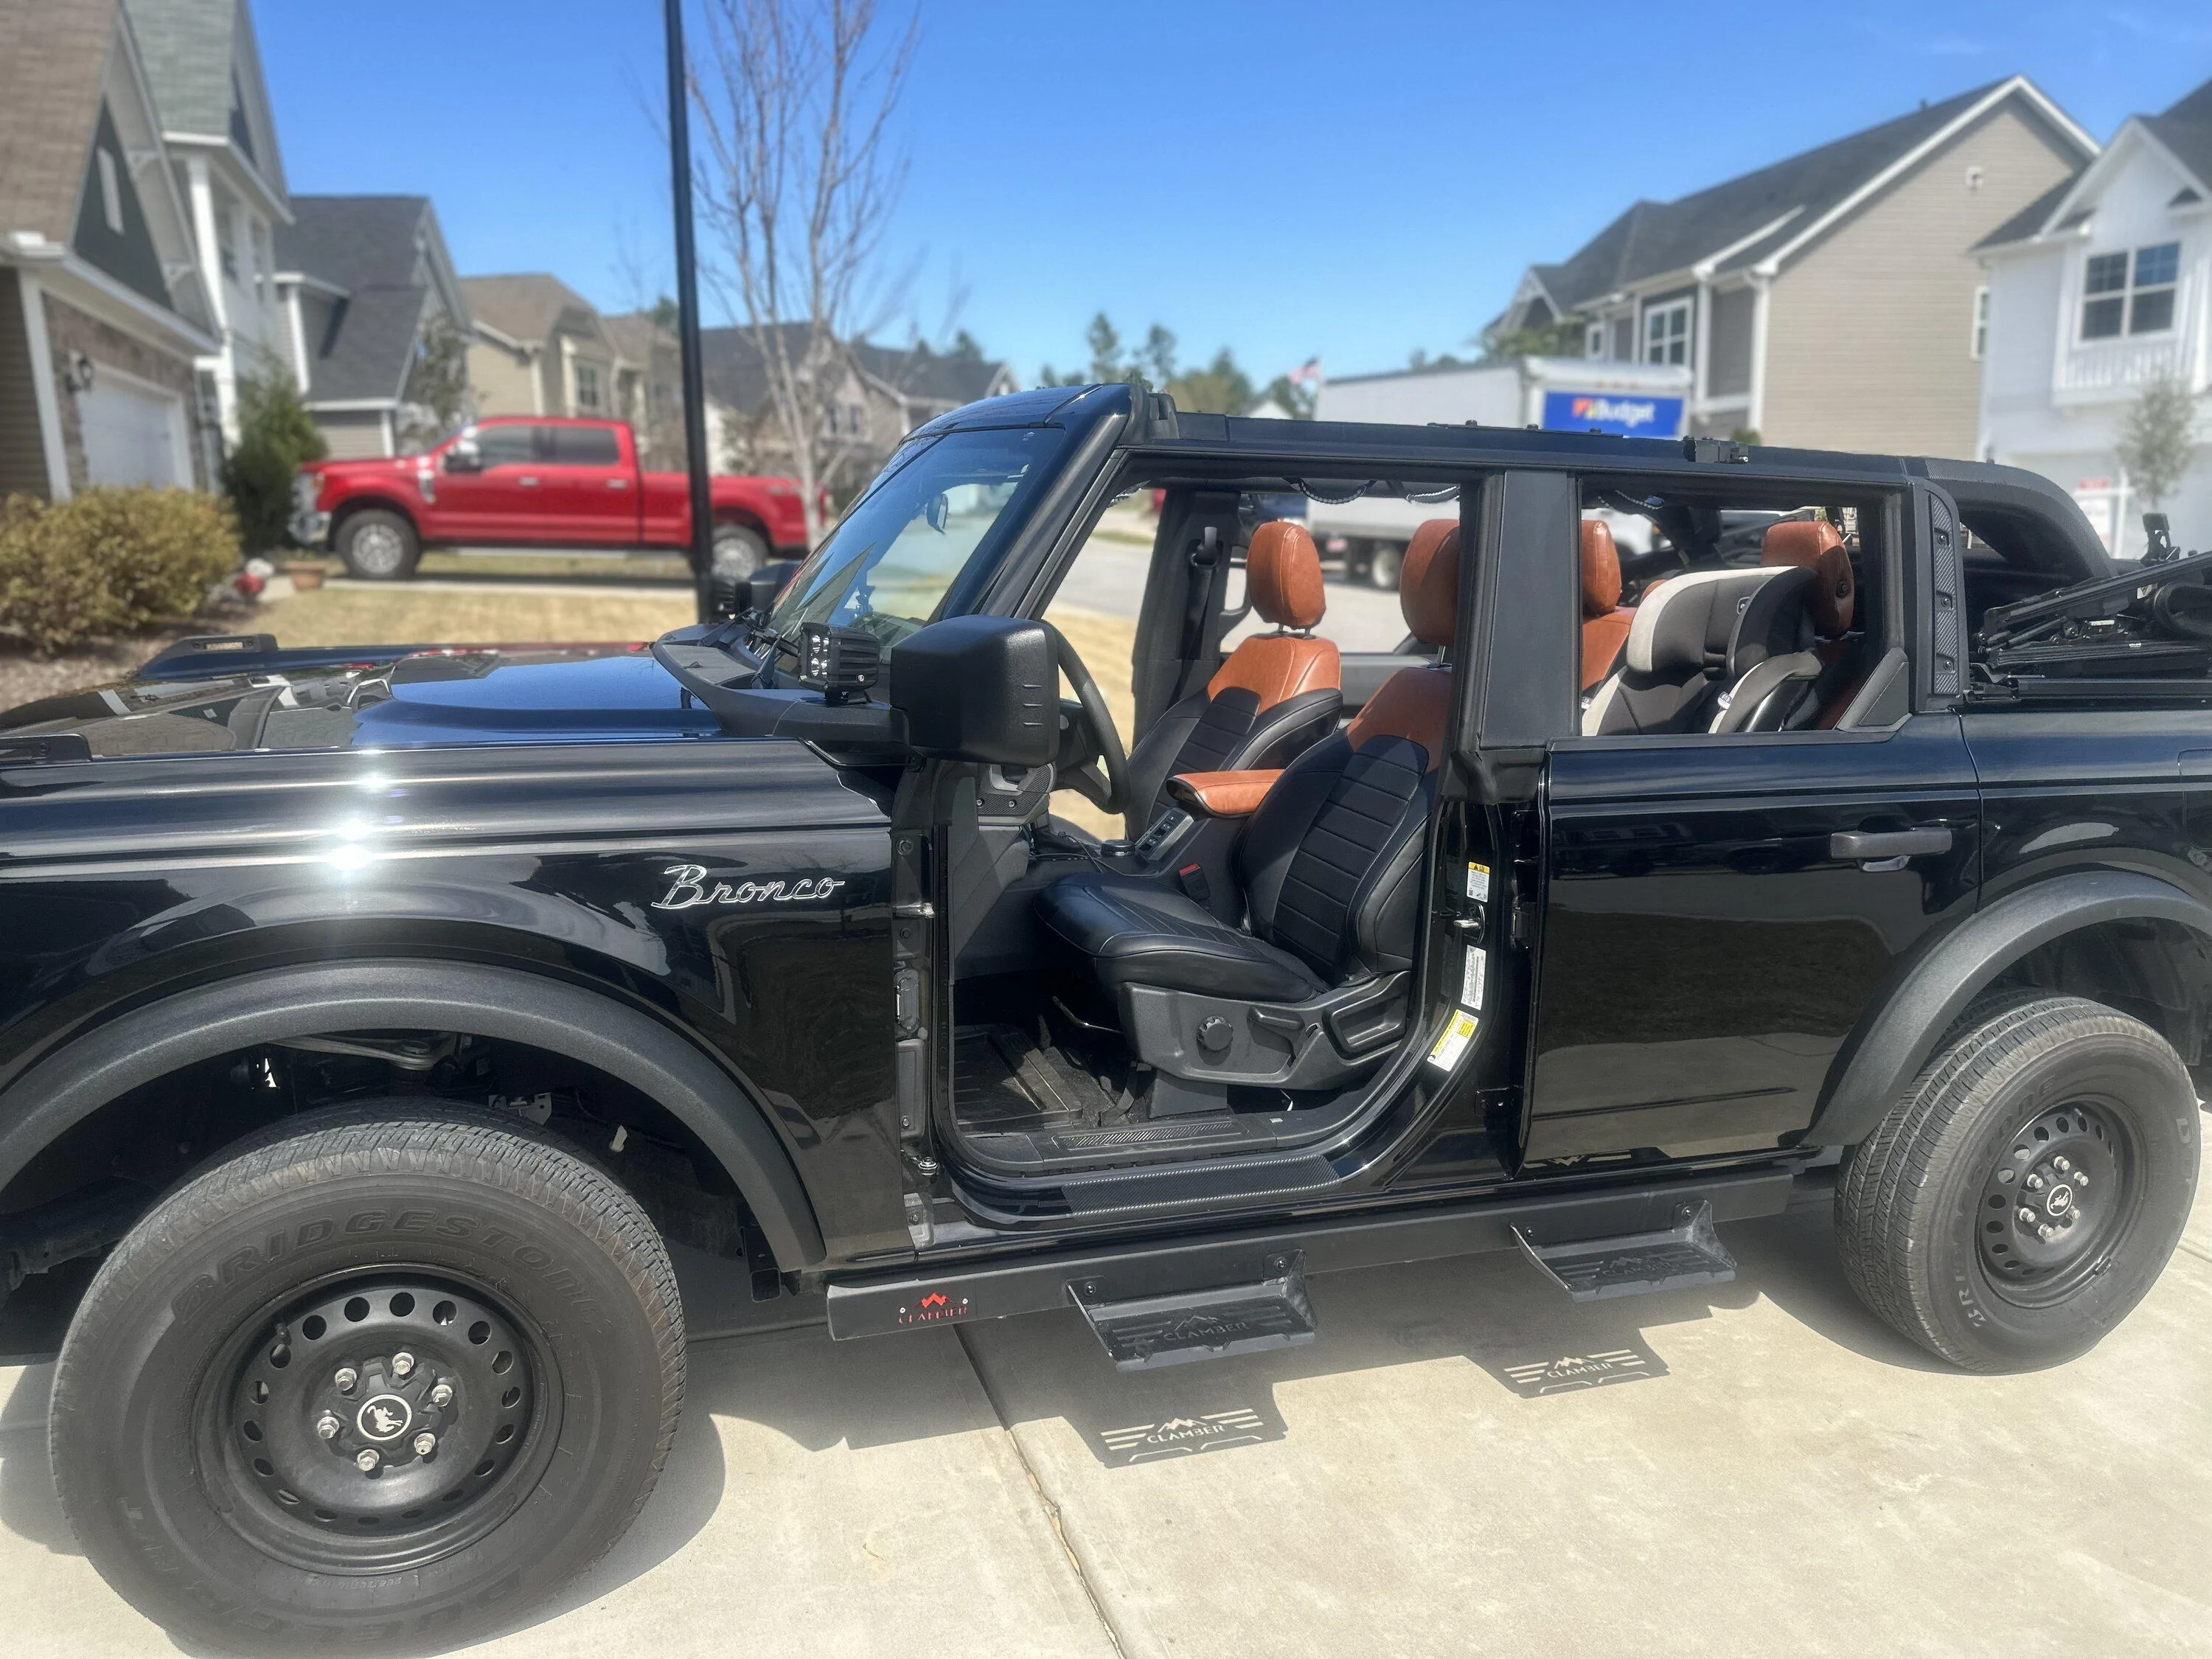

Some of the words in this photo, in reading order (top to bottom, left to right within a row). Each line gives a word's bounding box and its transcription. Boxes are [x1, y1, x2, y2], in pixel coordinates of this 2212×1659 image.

[1594, 398, 1655, 428] Budget
[650, 864, 846, 909] Bronco
[1163, 1321, 1250, 1340] CLAMBER
[1147, 1424, 1225, 1444] CLAMBER
